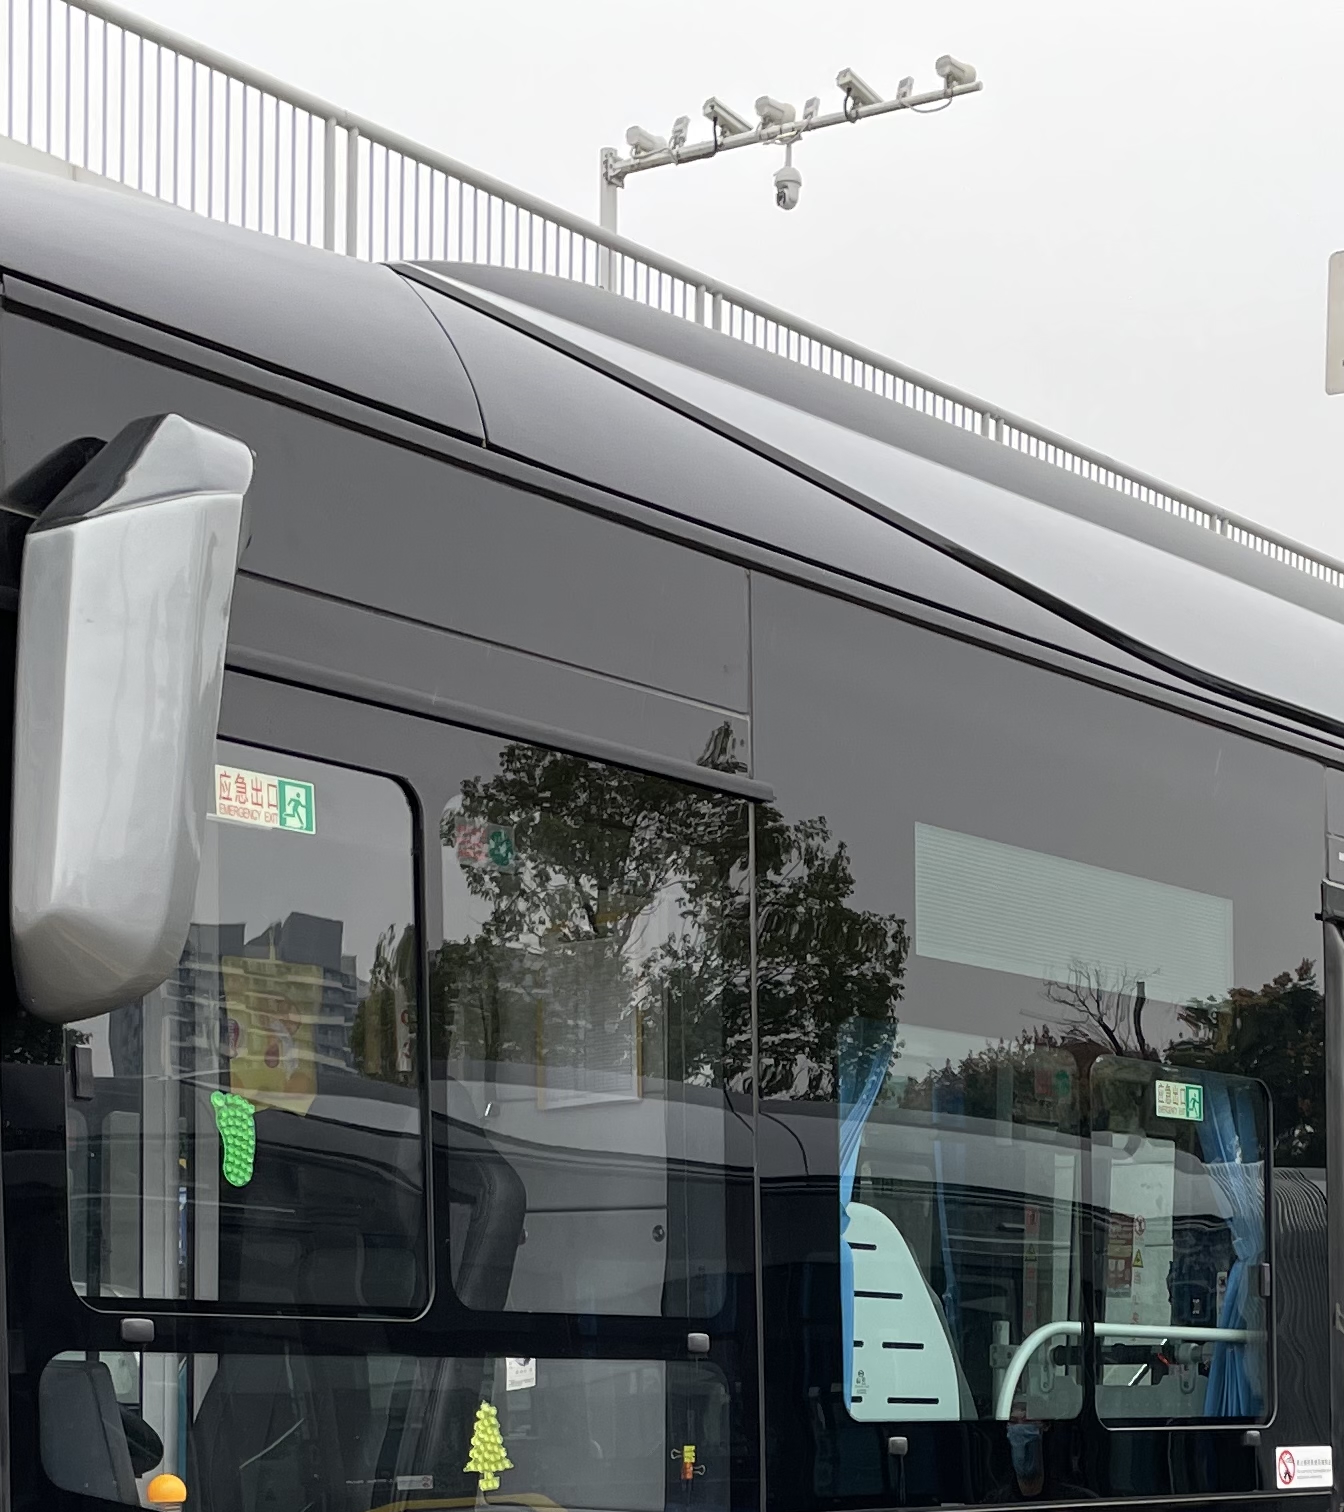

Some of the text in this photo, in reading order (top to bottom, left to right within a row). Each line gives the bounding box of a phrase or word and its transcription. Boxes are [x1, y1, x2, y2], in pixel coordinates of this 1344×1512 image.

[219, 769, 279, 810] 应急出口
[218, 802, 279, 824] EMERGENCY EXIT
